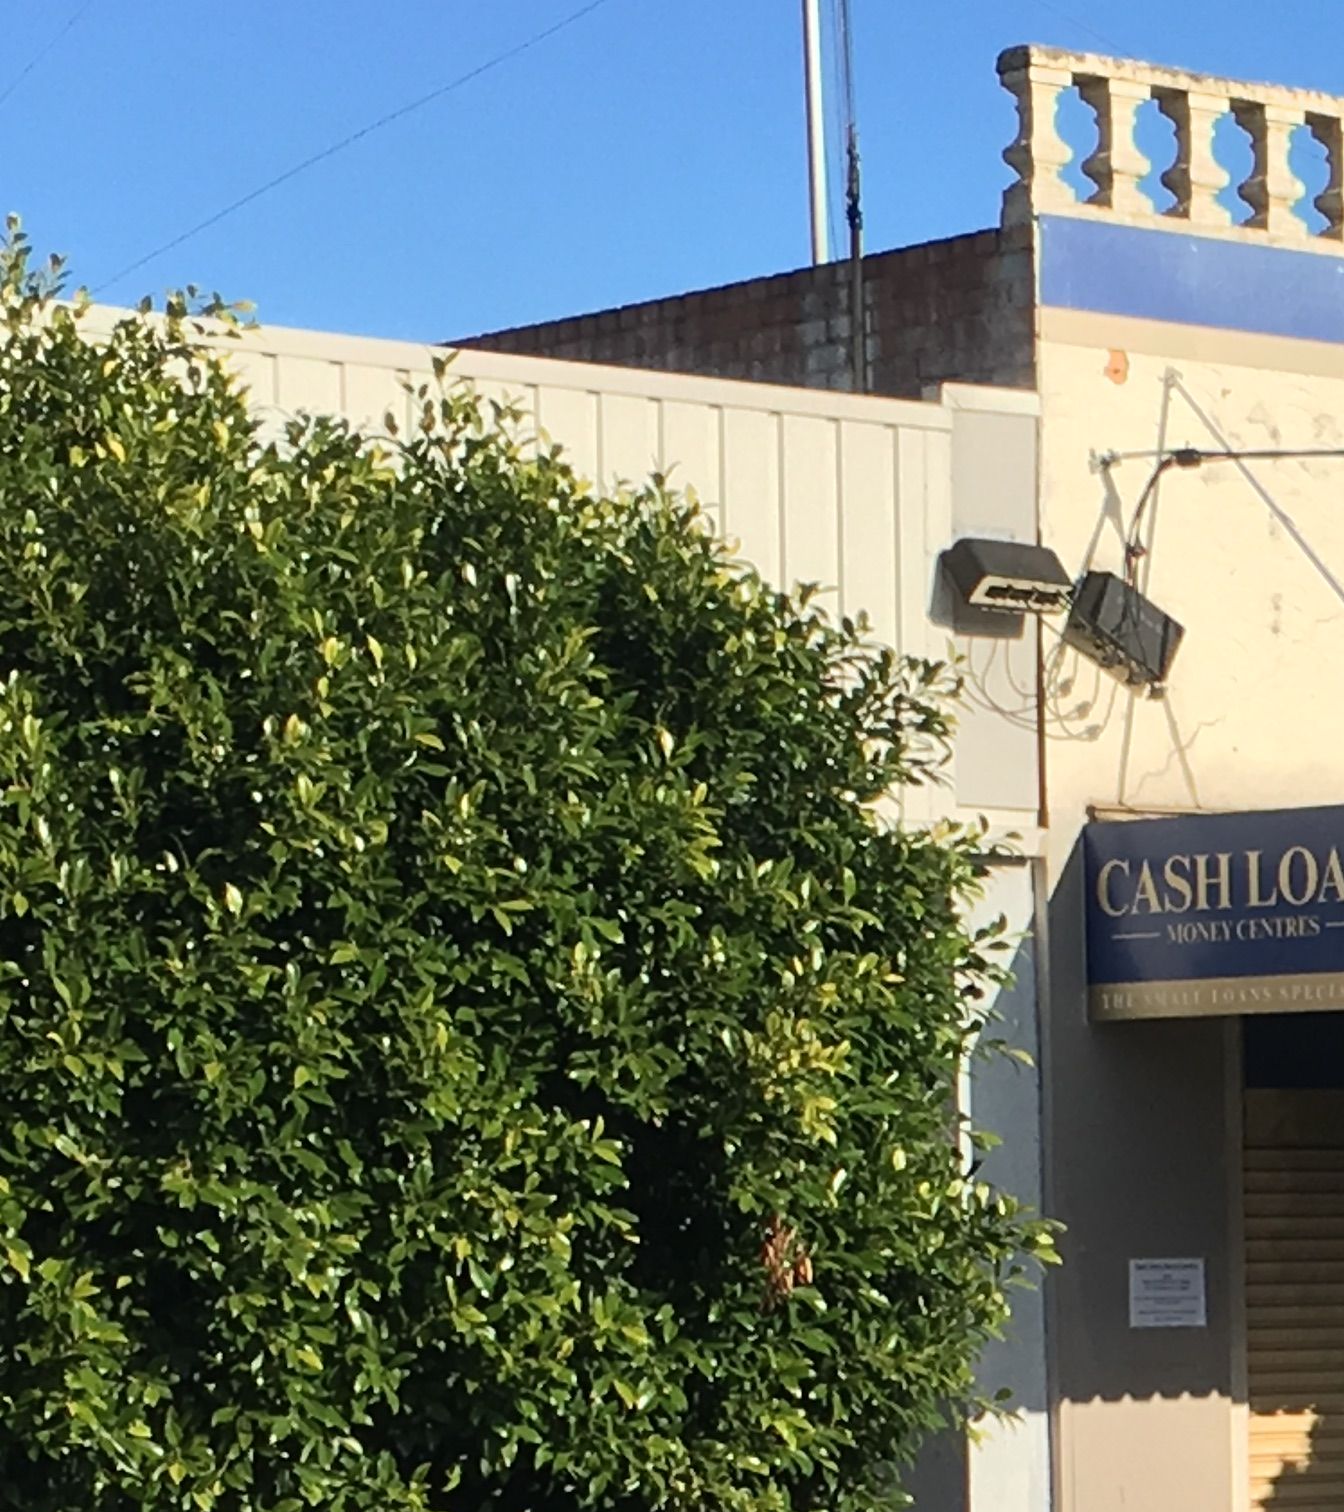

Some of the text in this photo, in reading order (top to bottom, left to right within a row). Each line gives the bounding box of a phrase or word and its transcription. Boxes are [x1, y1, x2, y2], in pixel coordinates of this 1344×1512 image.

[1096, 850, 1234, 919] CASH
[1167, 915, 1322, 945] MONEY CENTRES
[1101, 993, 1134, 1010] THE
[1143, 989, 1201, 1009] SMALL
[1211, 986, 1272, 1006] LOANS
